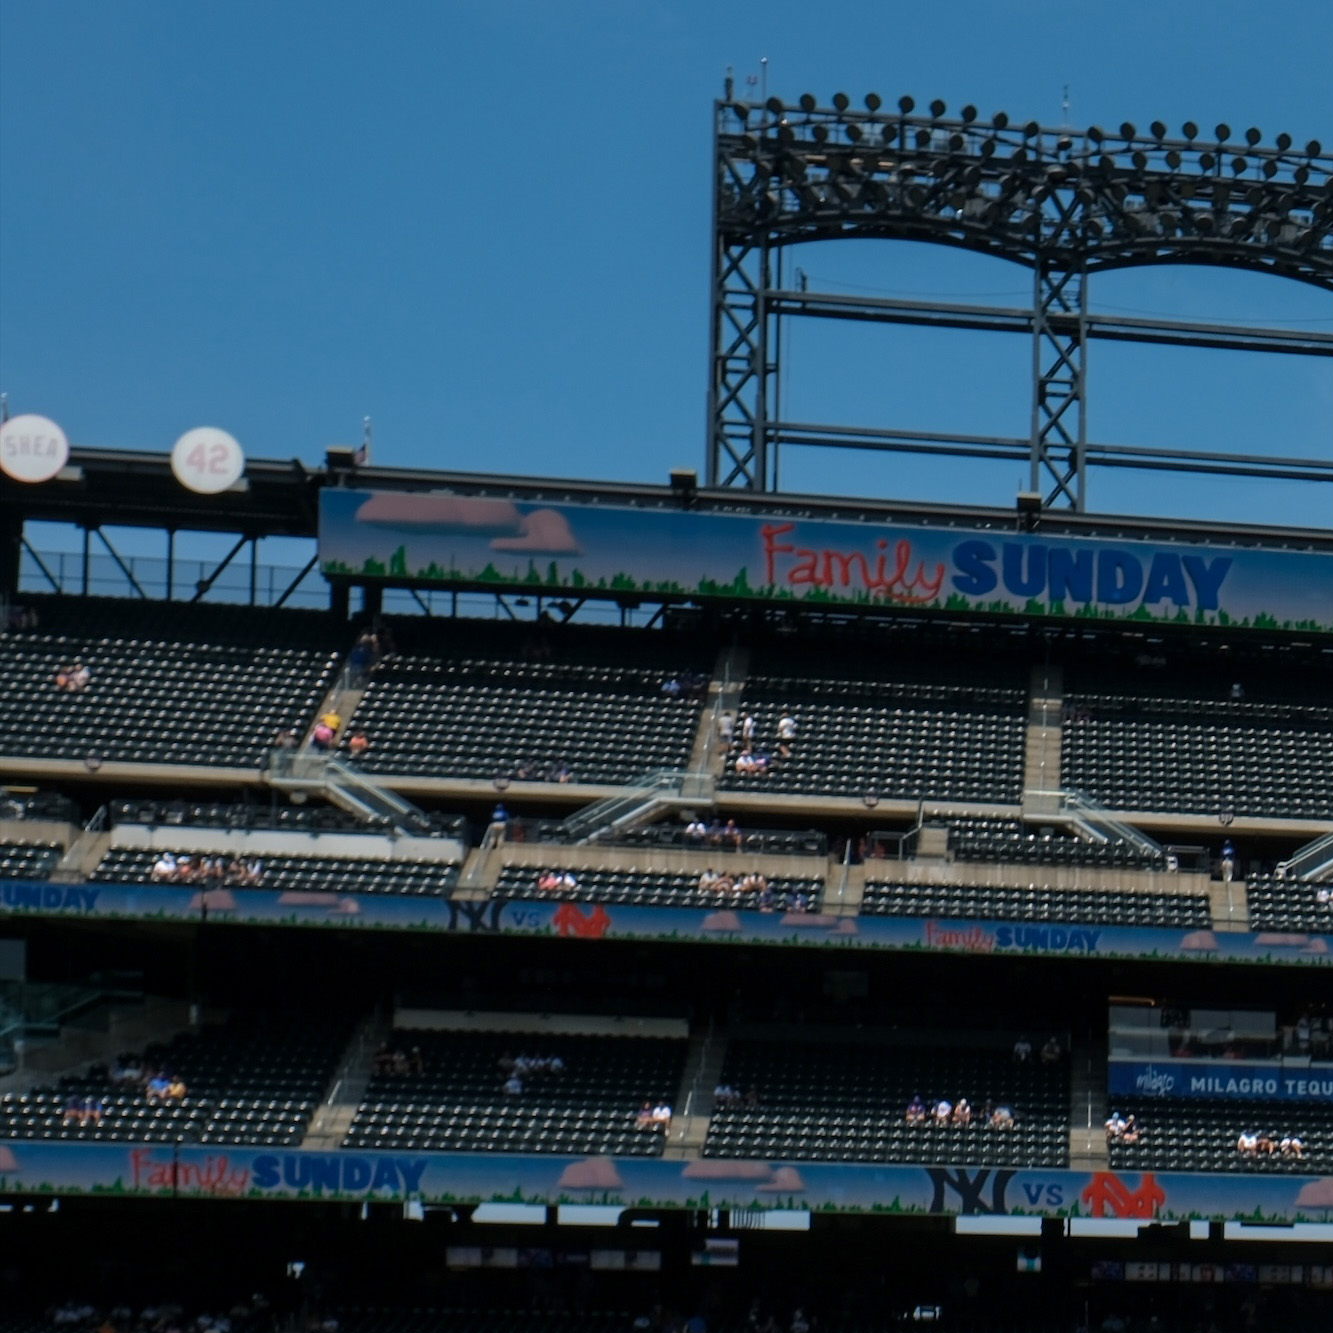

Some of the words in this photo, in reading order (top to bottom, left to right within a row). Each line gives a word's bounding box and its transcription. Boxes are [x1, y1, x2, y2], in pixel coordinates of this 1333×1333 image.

[4, 434, 60, 460] SHEA
[186, 444, 230, 475] 42
[759, 522, 945, 602] Family
[951, 540, 1233, 611] SUNDAY
[0, 885, 101, 910] UNDAY
[923, 920, 996, 954] Family
[996, 927, 1101, 953] SUNDAY
[1136, 1065, 1175, 1095] milagro
[1191, 1076, 1277, 1096] MILAGRO
[129, 1147, 249, 1197] Family
[252, 1156, 429, 1193] SUNDAY
